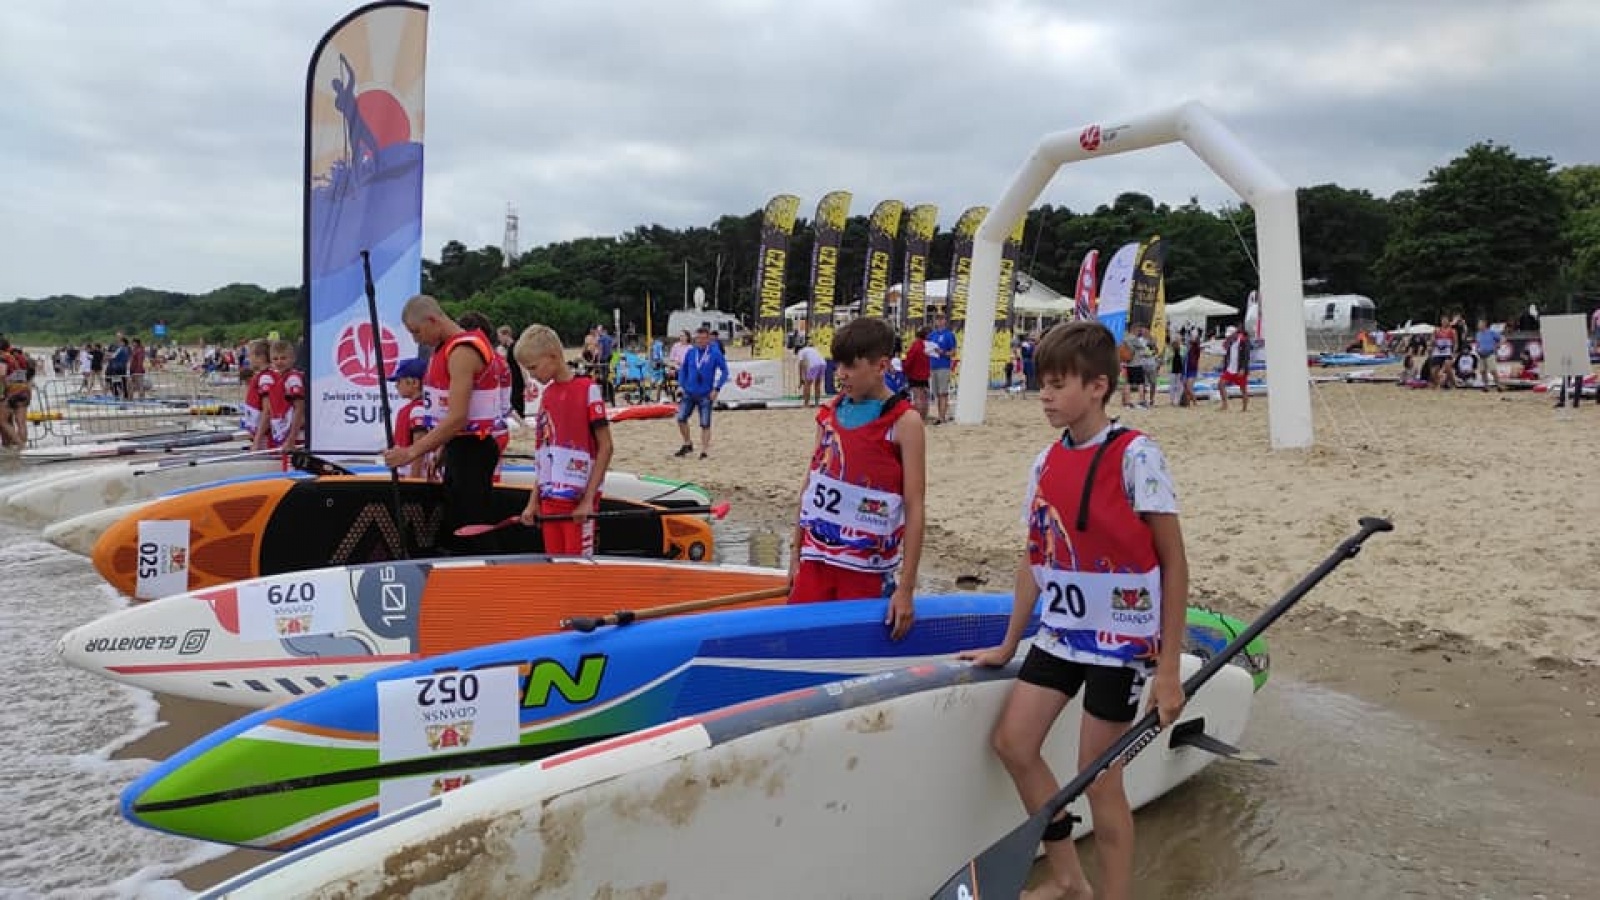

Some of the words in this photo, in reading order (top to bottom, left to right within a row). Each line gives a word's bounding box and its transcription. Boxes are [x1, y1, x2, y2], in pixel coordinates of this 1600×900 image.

[813, 483, 842, 515] 52
[140, 543, 158, 578] 025
[267, 582, 316, 605] 079
[1047, 581, 1086, 618] 20
[415, 674, 478, 706] 052
